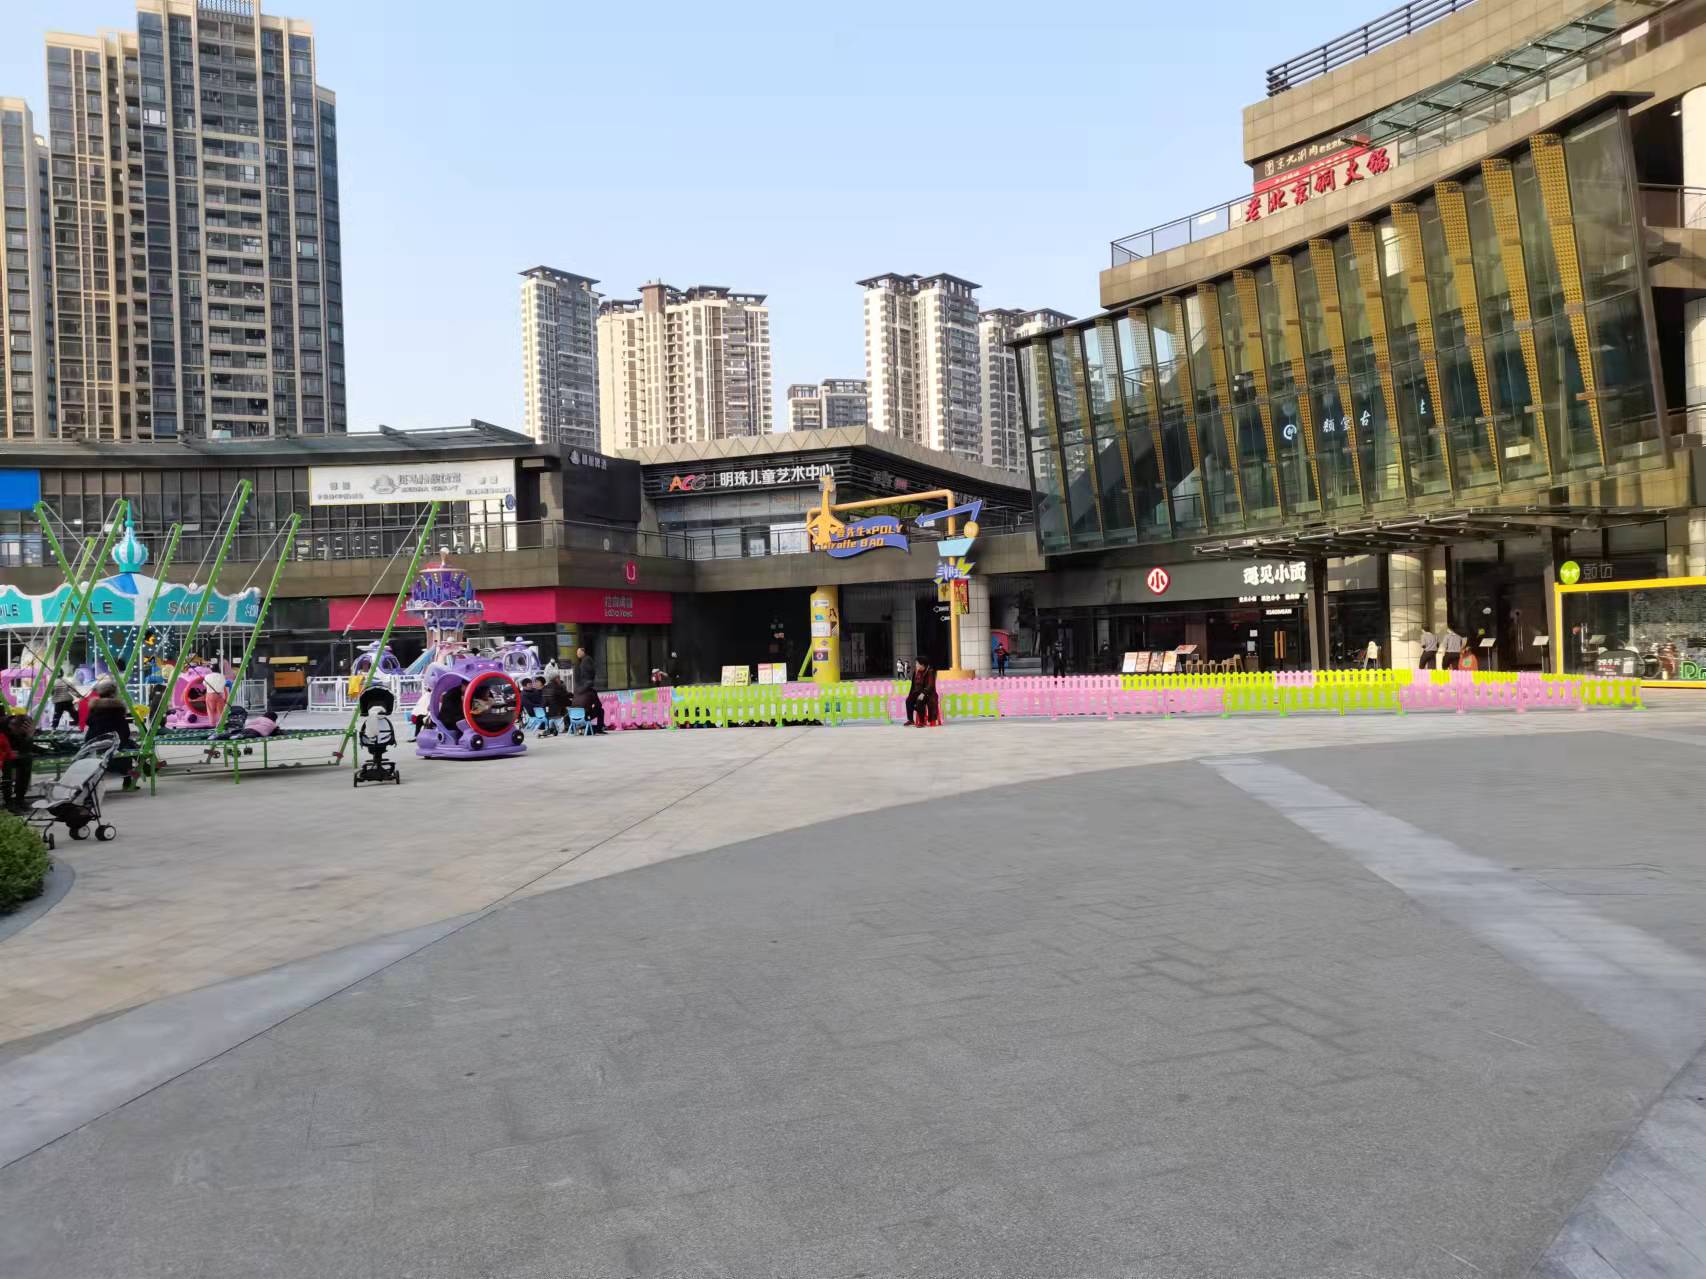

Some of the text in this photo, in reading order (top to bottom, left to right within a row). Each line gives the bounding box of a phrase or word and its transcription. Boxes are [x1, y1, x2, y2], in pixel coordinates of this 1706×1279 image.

[719, 463, 834, 488] 明珠儿童艺术中心
[1243, 561, 1306, 586] 遇见小面
